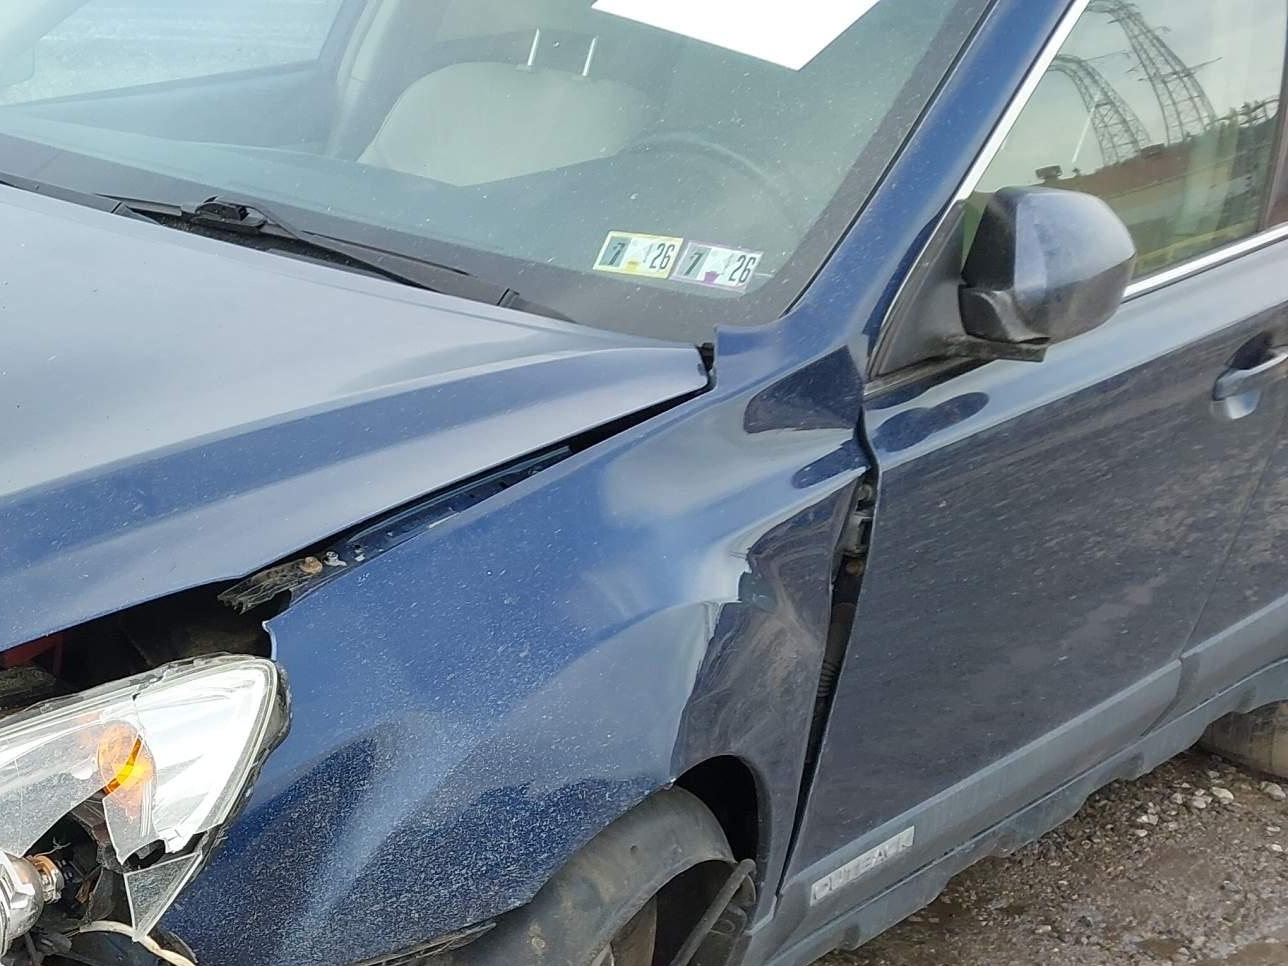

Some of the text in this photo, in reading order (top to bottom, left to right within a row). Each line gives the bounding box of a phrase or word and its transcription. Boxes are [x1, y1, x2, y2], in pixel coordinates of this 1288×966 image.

[608, 242, 676, 270] 7 26
[684, 252, 757, 283] 7 26
